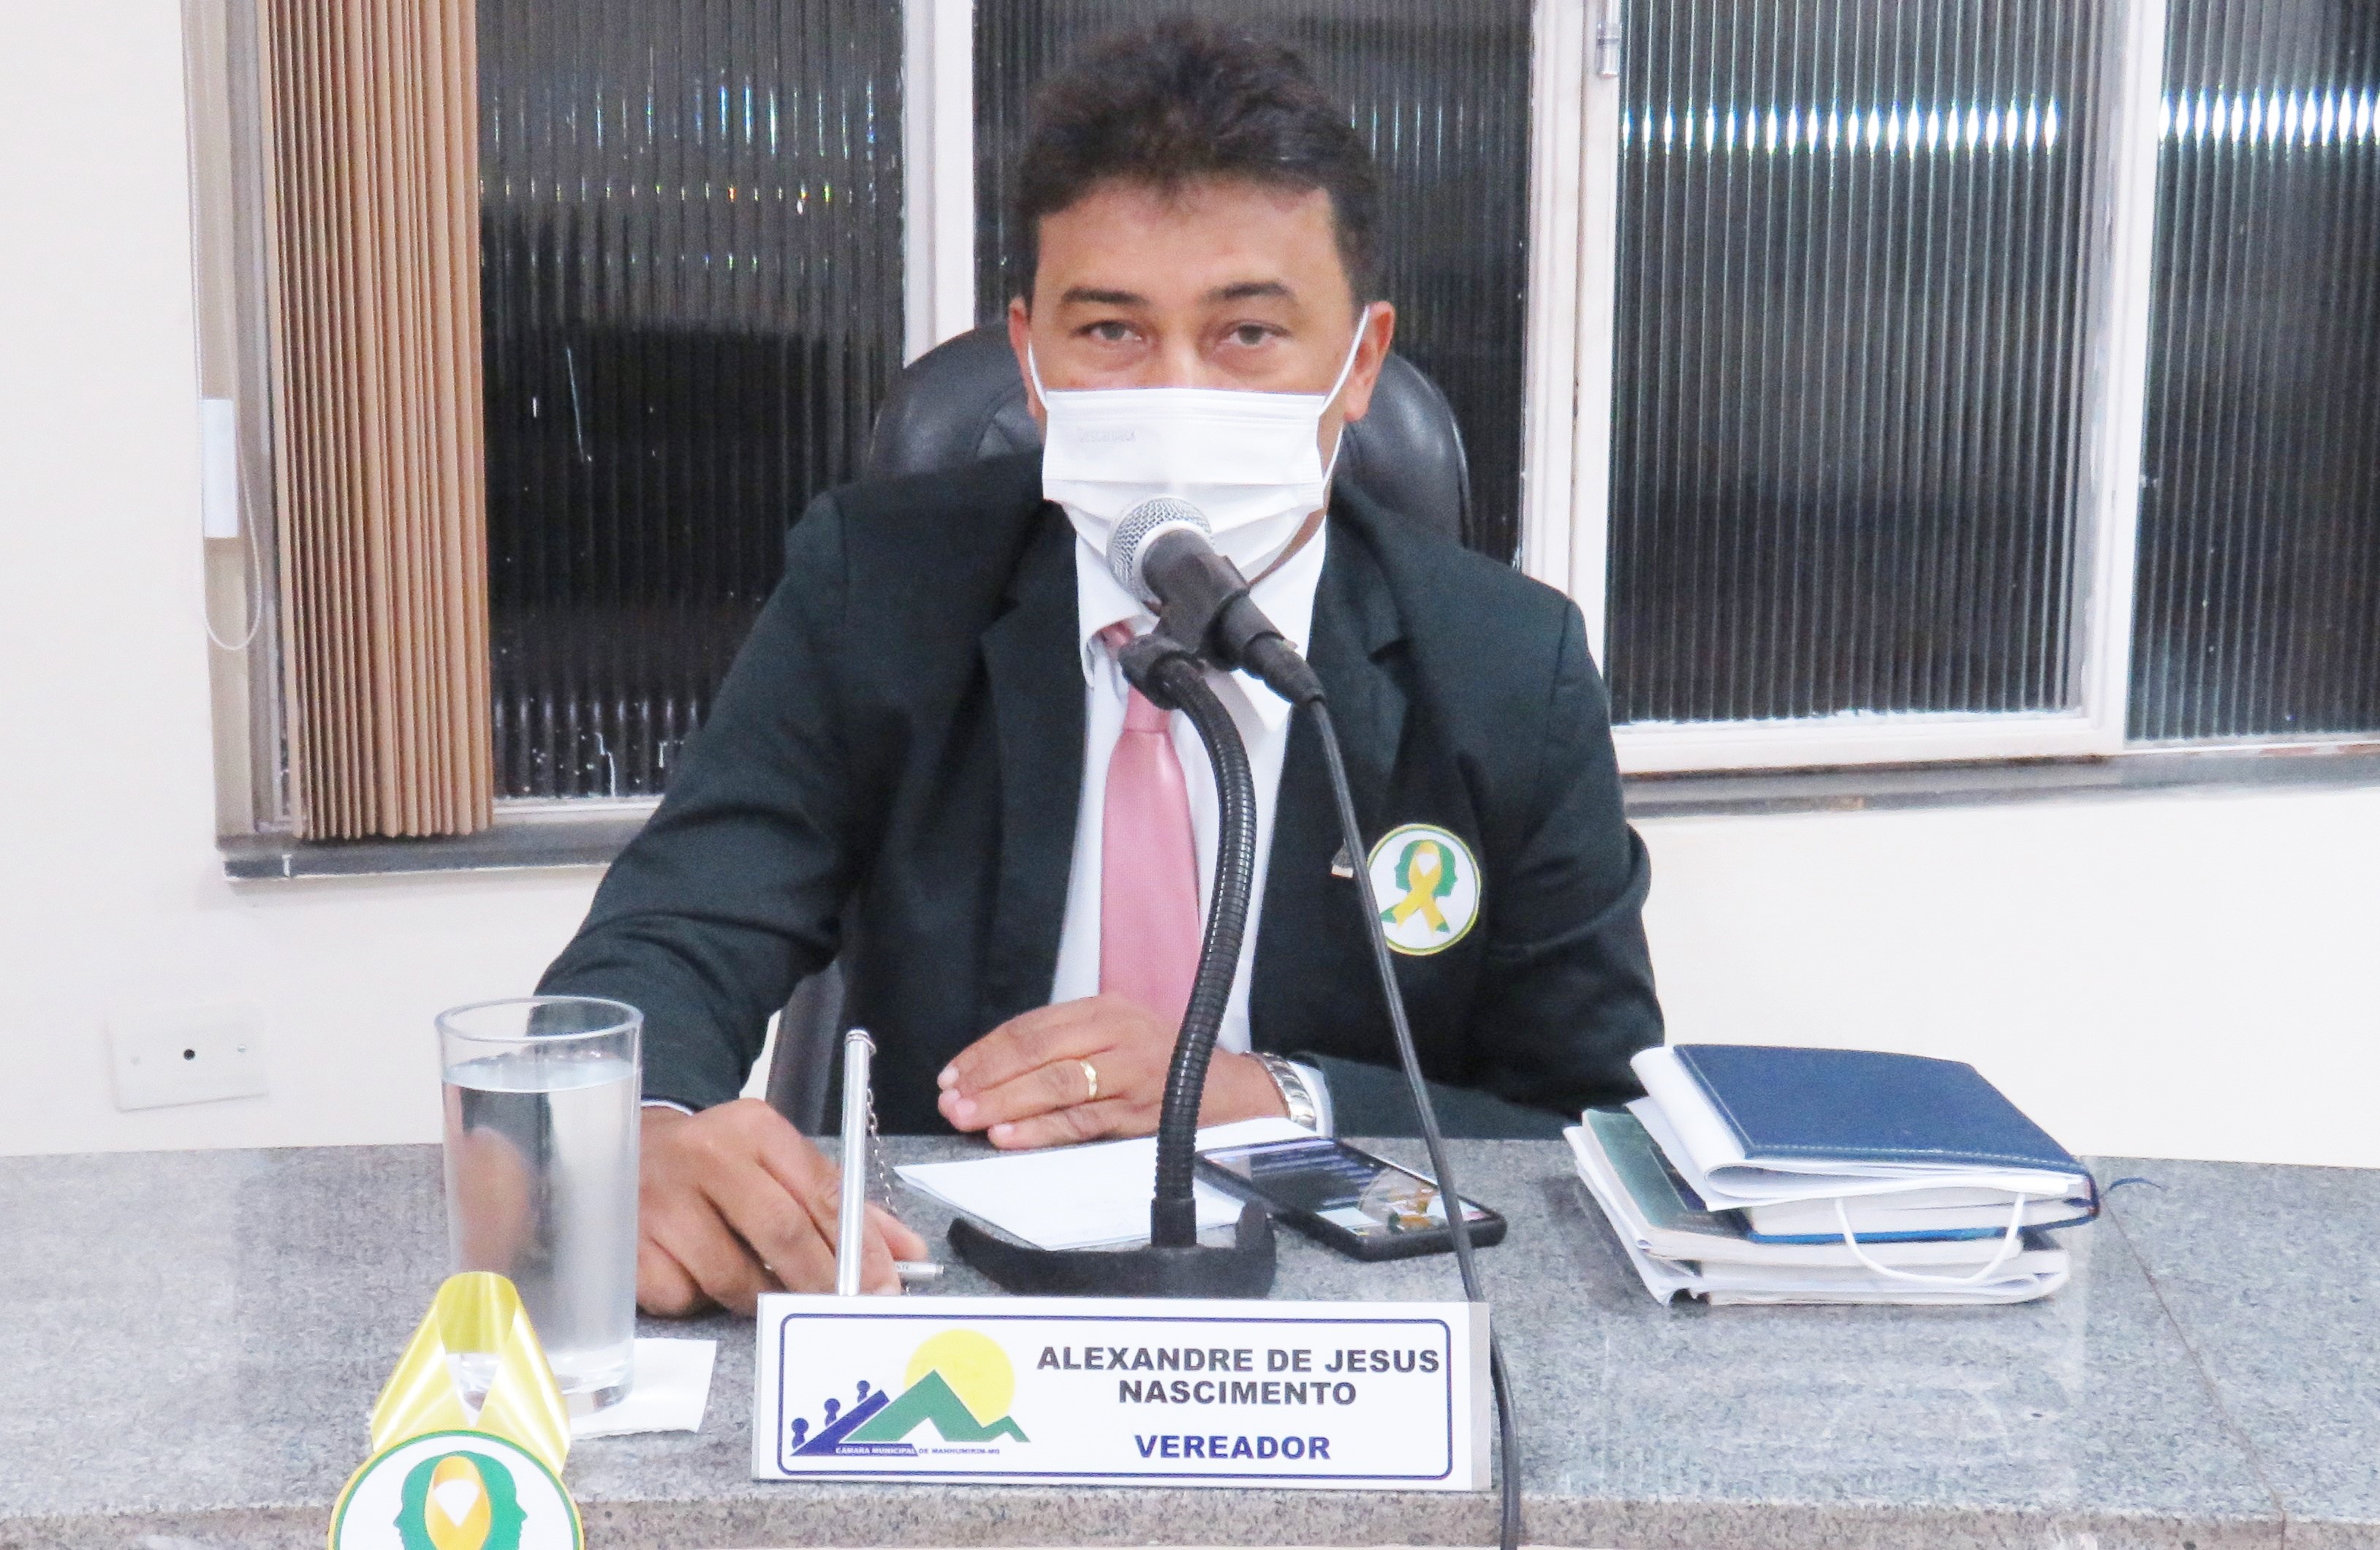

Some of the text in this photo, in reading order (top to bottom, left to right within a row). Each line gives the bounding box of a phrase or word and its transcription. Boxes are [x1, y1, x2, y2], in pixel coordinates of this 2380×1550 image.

[1038, 1347, 1440, 1373] ALEXANDRE DE JESUS
[1118, 1380, 1356, 1405] NASCIMENTO
[871, 1447, 917, 1456] MUNICIPAL
[1134, 1434, 1330, 1460] VEREADOR
